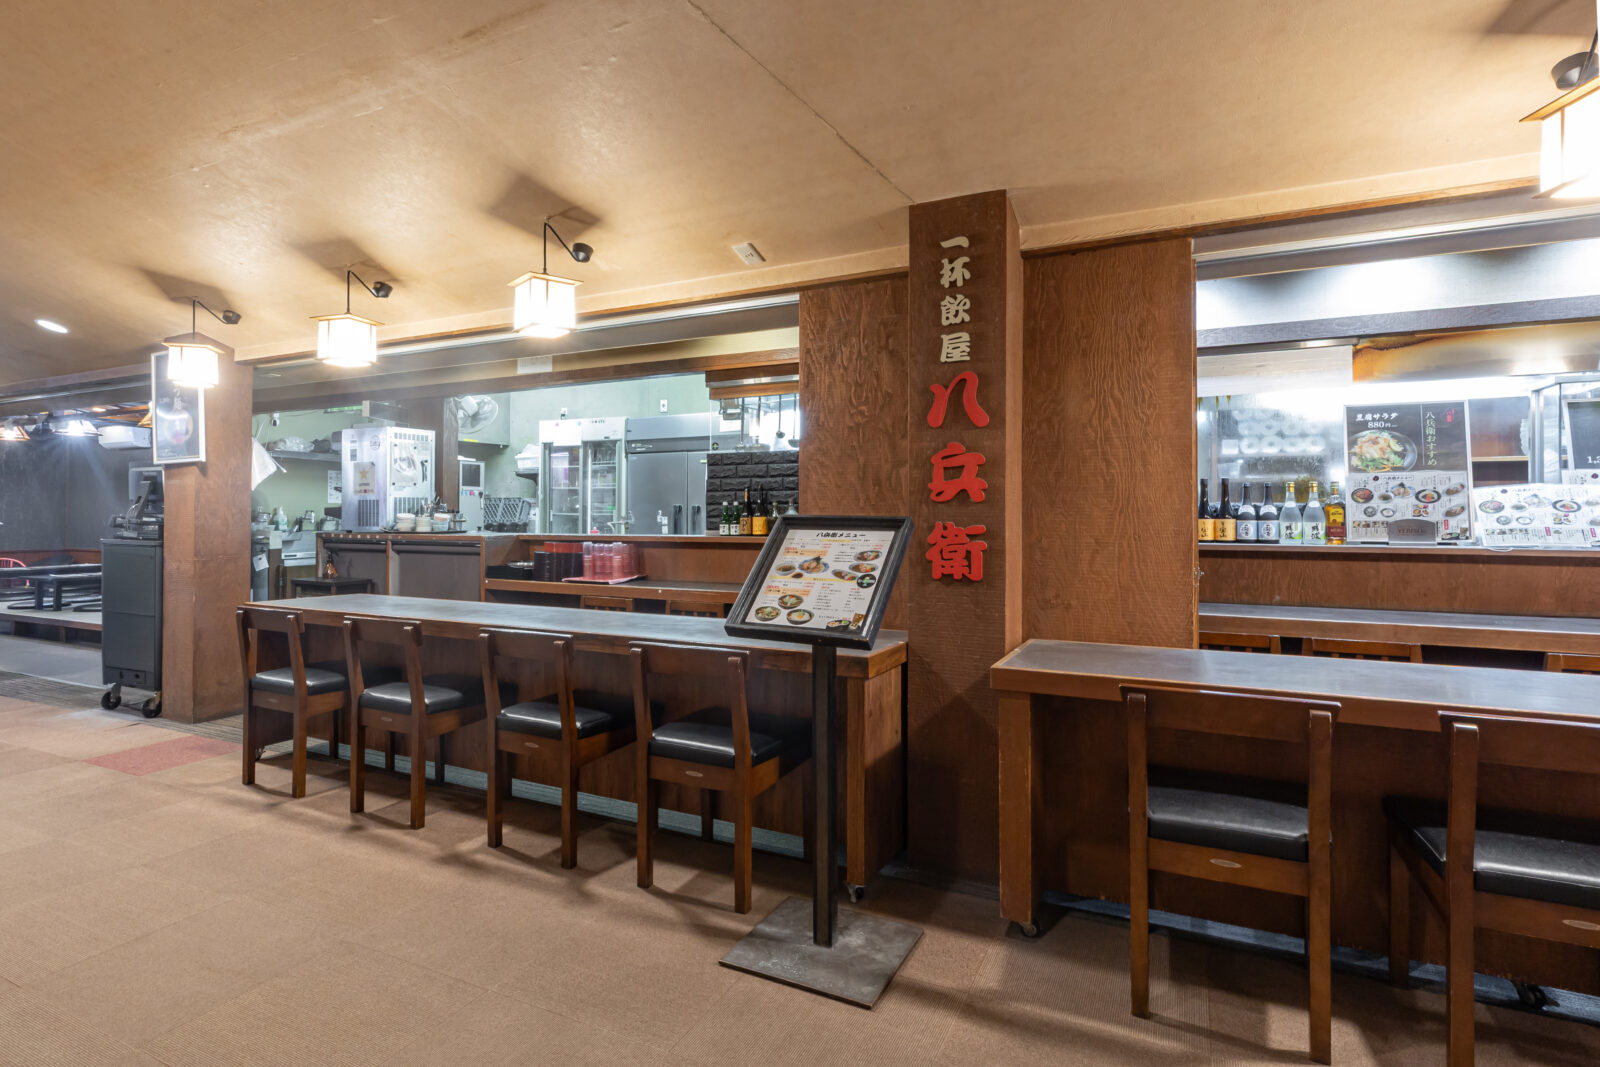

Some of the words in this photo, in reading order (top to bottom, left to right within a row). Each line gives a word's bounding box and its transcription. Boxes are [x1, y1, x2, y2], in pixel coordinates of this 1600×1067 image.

[940, 235, 971, 363] 一杯飲屋
[926, 371, 990, 581] 八兵衛
[1425, 411, 1438, 466] 八兵衛おすすめ
